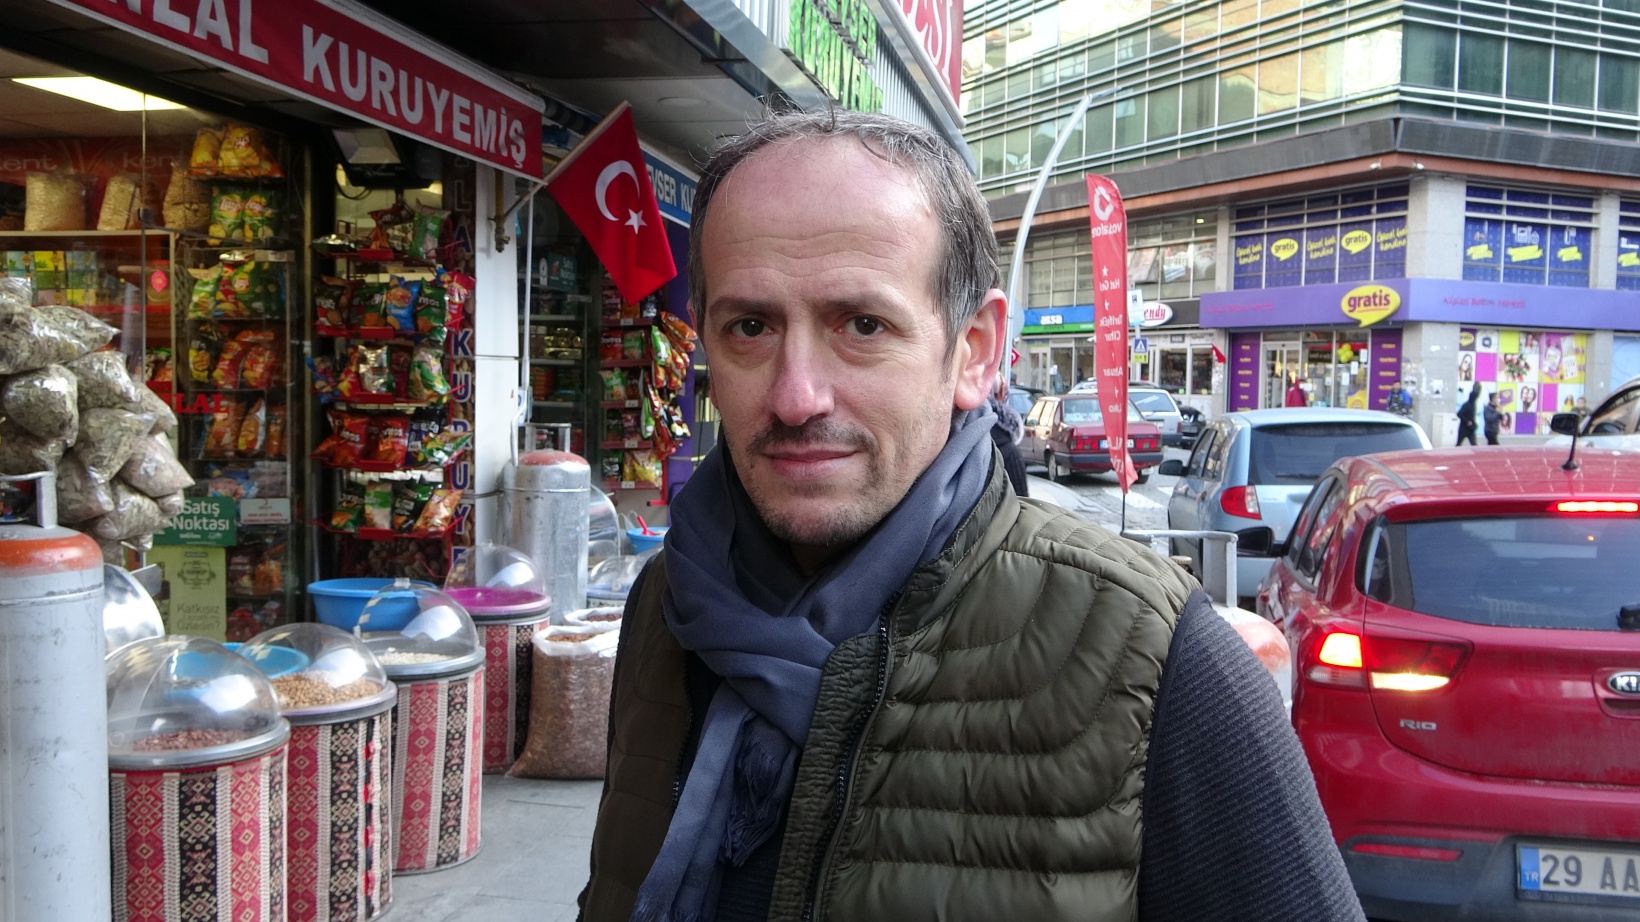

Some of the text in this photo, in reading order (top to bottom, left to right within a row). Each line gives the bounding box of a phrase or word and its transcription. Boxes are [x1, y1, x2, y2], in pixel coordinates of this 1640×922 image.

[302, 24, 527, 168] KURUYEMİŞ
[1345, 232, 1368, 246] gratis
[1274, 241, 1295, 253] gratis
[1347, 290, 1390, 313] gratis
[181, 500, 220, 517] Satış
[172, 515, 230, 531] Noktası
[1616, 676, 1640, 691] KI
[1400, 718, 1437, 731] RIO
[1524, 871, 1539, 882] TR
[1541, 853, 1640, 892] 29 AA
